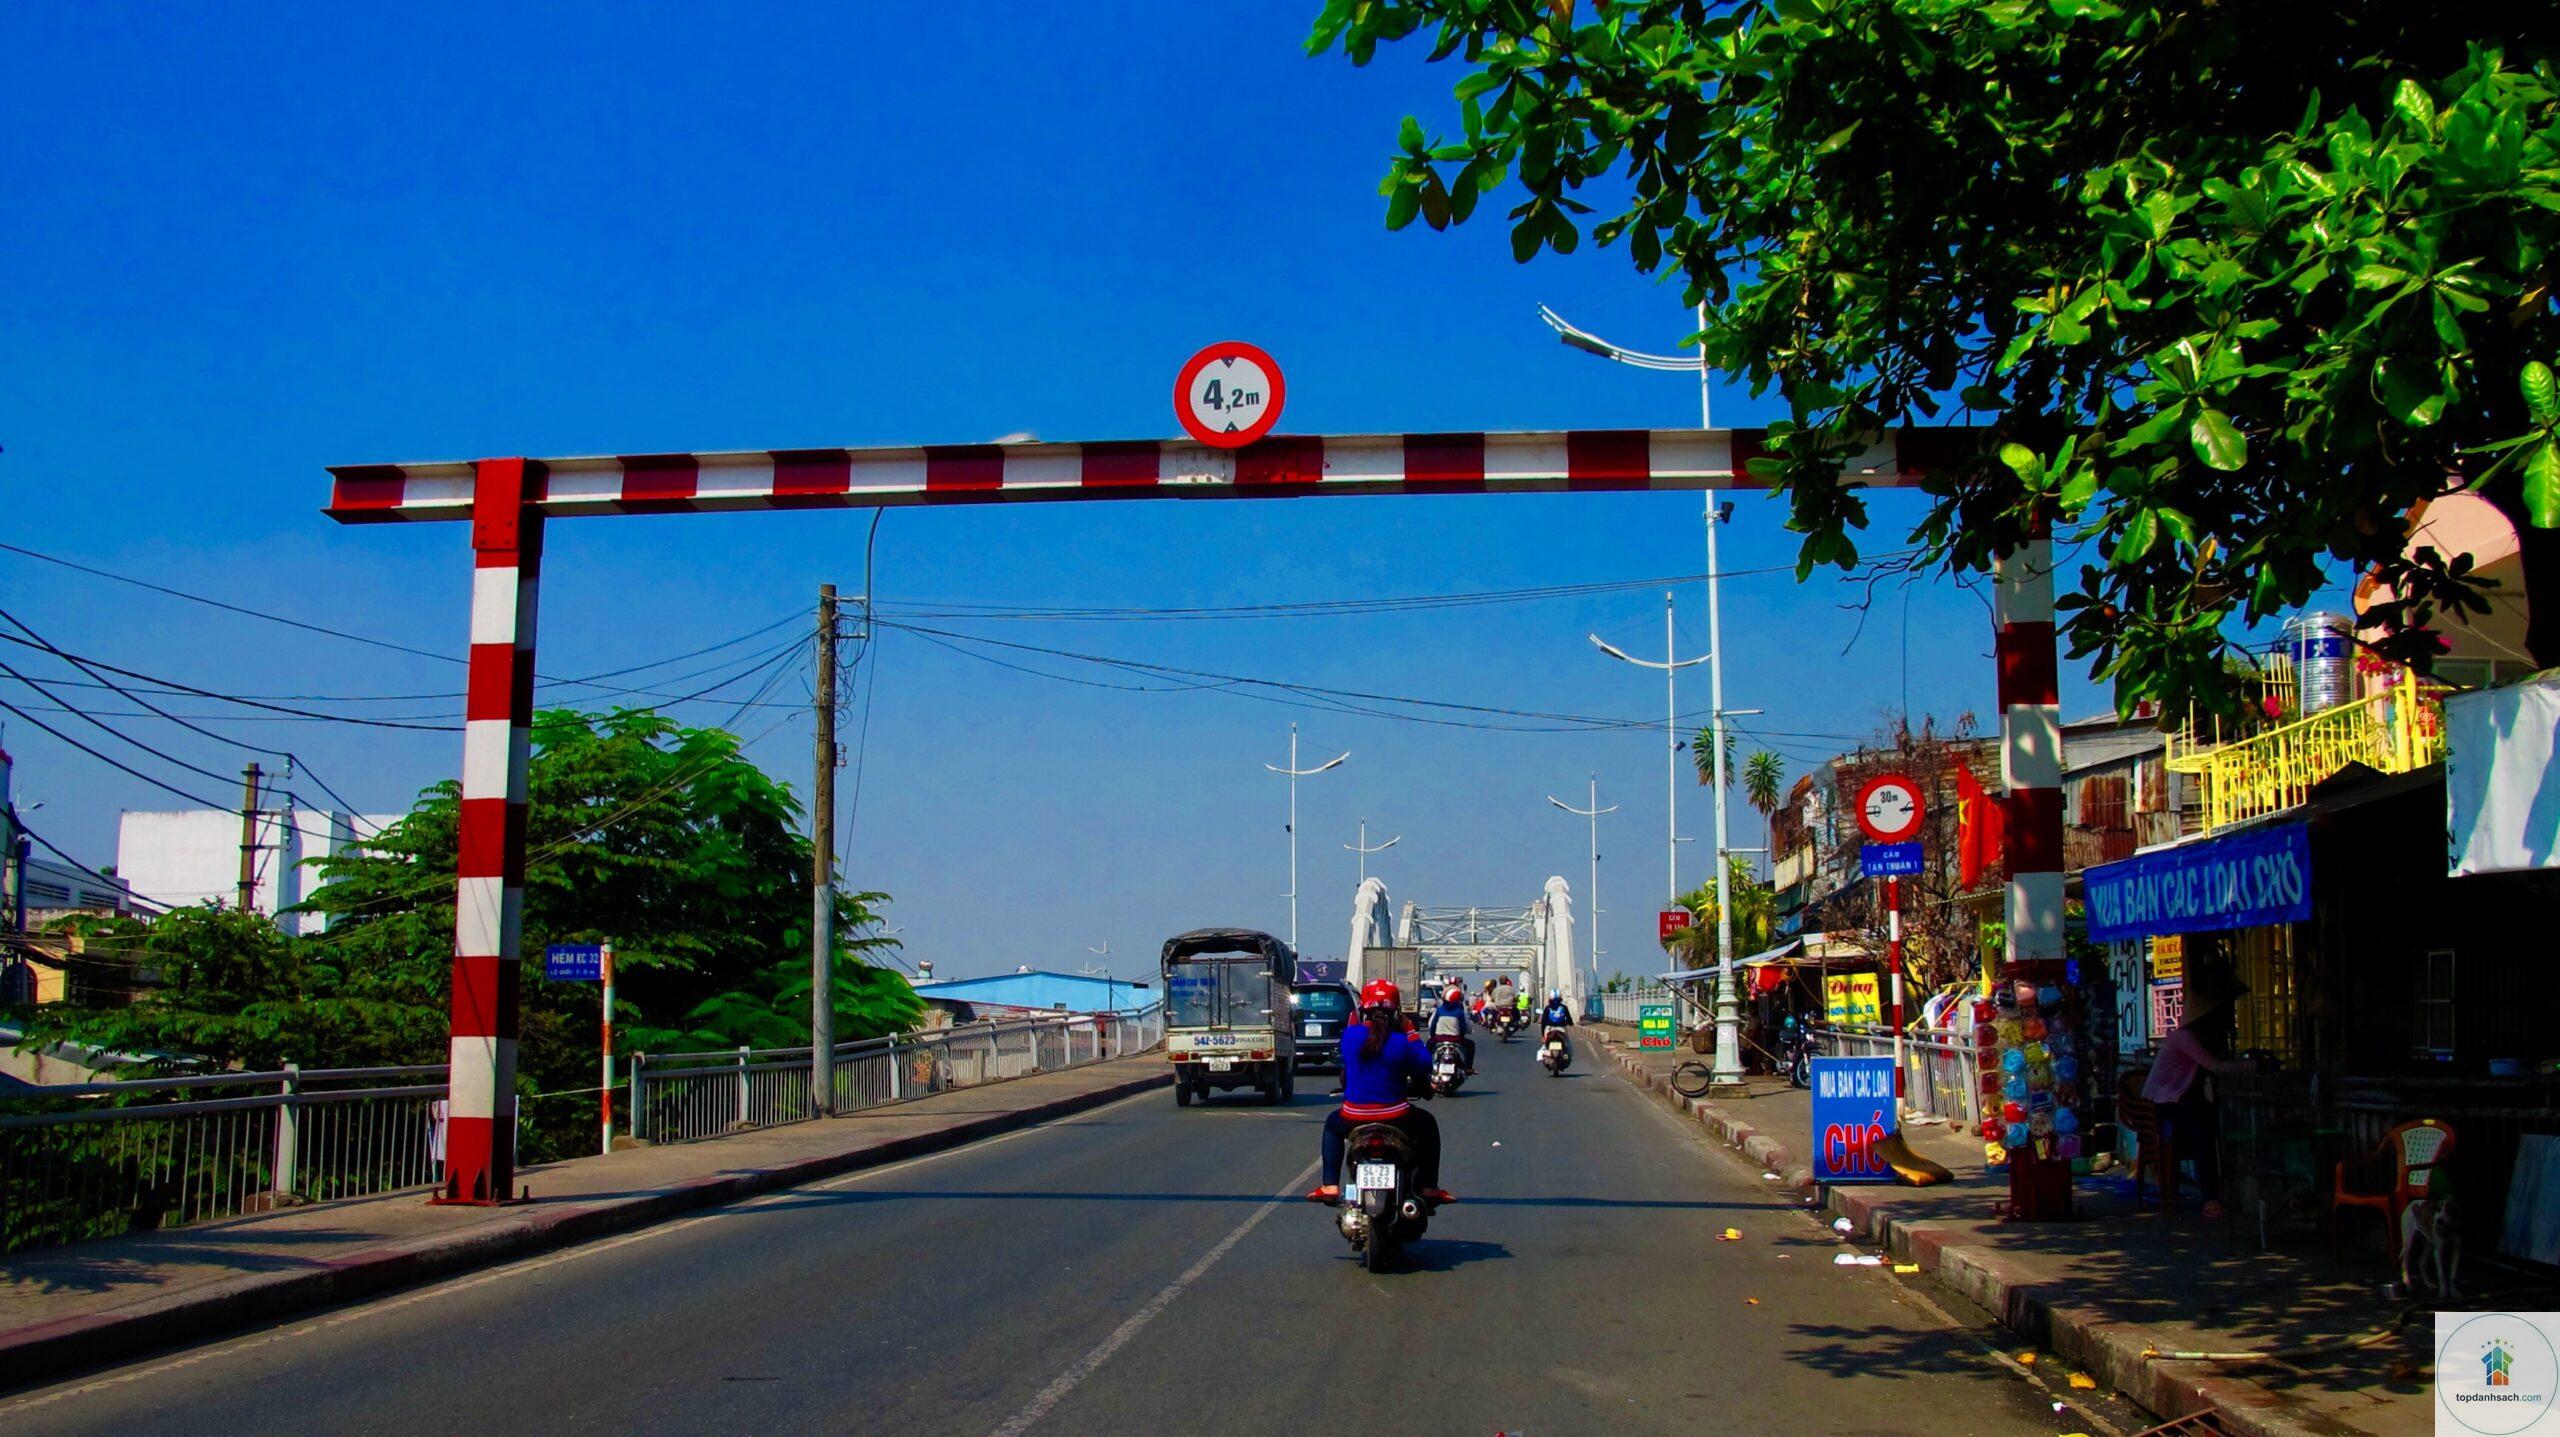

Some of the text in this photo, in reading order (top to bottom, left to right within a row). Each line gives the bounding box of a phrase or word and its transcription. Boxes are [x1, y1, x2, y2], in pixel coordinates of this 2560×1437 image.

[1203, 378, 1260, 414] 4,2m
[1880, 790, 1899, 803] 30m
[2091, 834, 2303, 928] MUA BÁN CÁC LOẠI CHÓ
[588, 952, 599, 964] 32
[1641, 1035, 1672, 1047] Chó
[1819, 1062, 1890, 1105] MUA BÁN CÁC LOẠI
[1823, 1109, 1889, 1175] CHÓ
